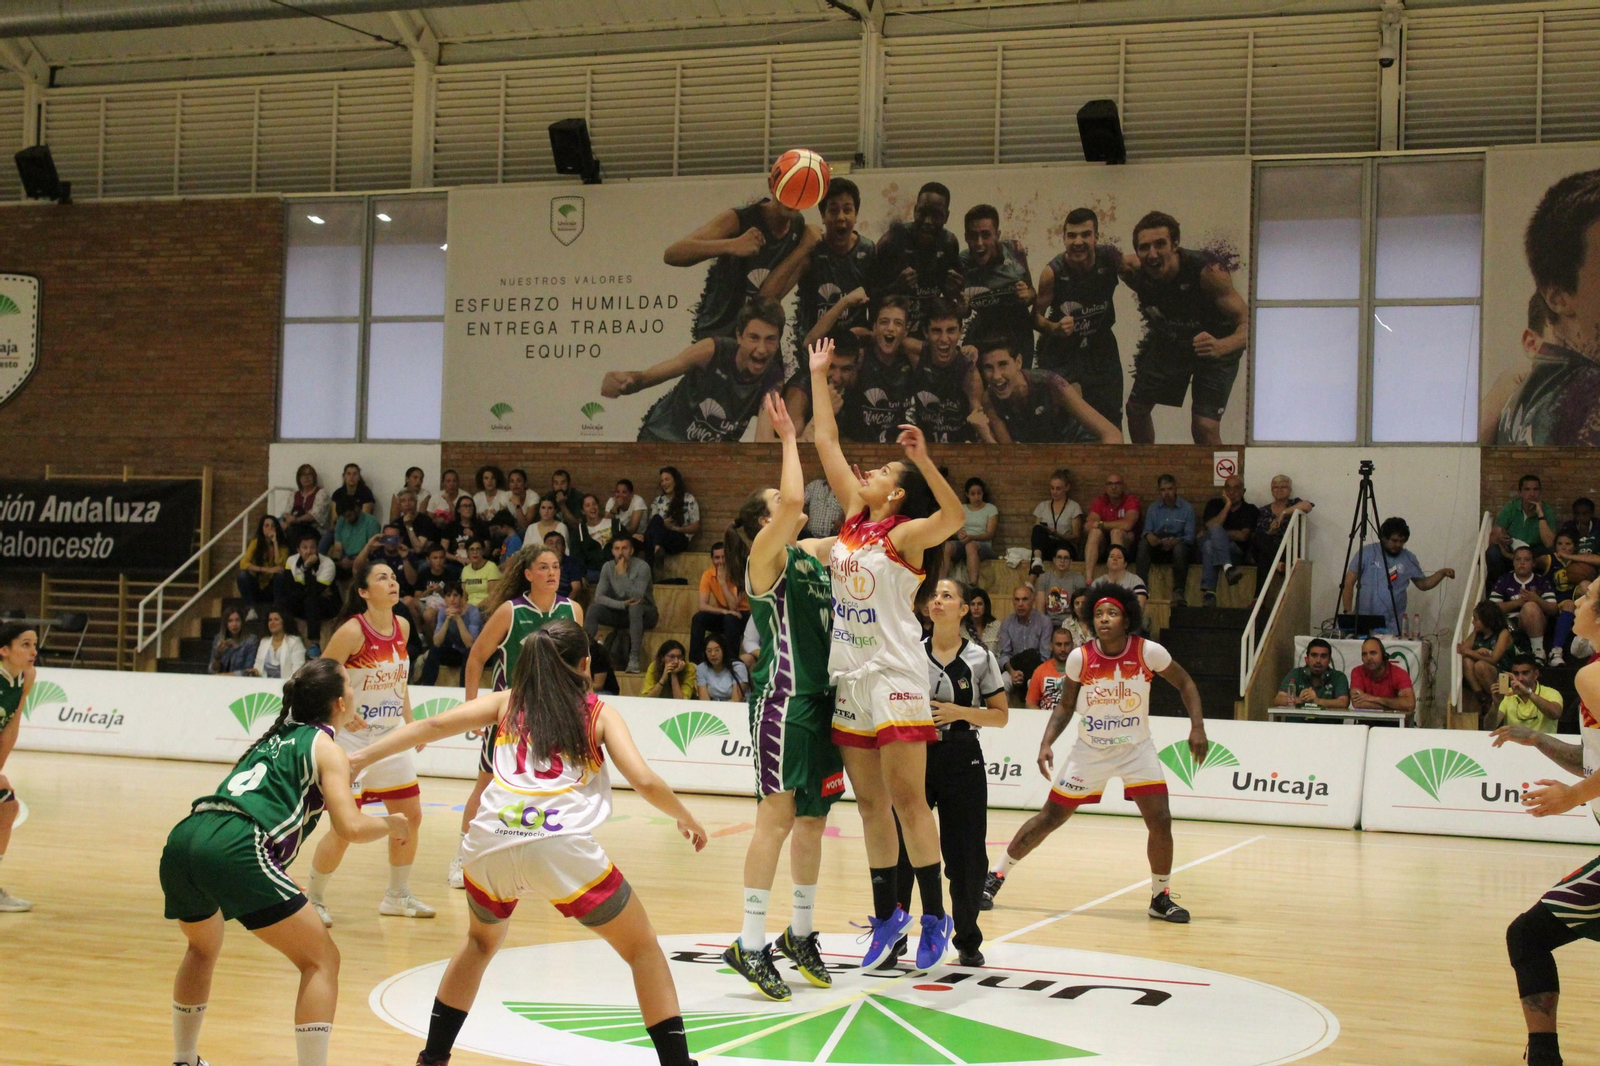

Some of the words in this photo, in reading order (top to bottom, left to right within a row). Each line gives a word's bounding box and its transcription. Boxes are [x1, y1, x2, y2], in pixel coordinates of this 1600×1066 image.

[500, 276, 566, 286] NUESTROS
[575, 275, 633, 284] VALORES
[455, 297, 559, 313] ESFUERZO
[572, 295, 678, 311] HUMILDAD
[467, 321, 558, 336] ENTREGA
[571, 319, 664, 334] TRABAJO
[525, 344, 602, 359] EQUIPO
[581, 423, 603, 432] Unicaja
[39, 495, 161, 523] Andaluza
[0, 530, 114, 559] aloncesto
[853, 576, 866, 593] 12
[374, 664, 407, 684] Sevilla
[362, 675, 396, 691] Femenino
[1094, 681, 1132, 699] Sevilla
[889, 692, 910, 701] CBS
[1086, 692, 1120, 707] Femenino
[1124, 698, 1136, 708] 10
[58, 706, 125, 729] Unicaja
[1086, 715, 1140, 732] Beiman
[1232, 771, 1329, 800] Unicaja
